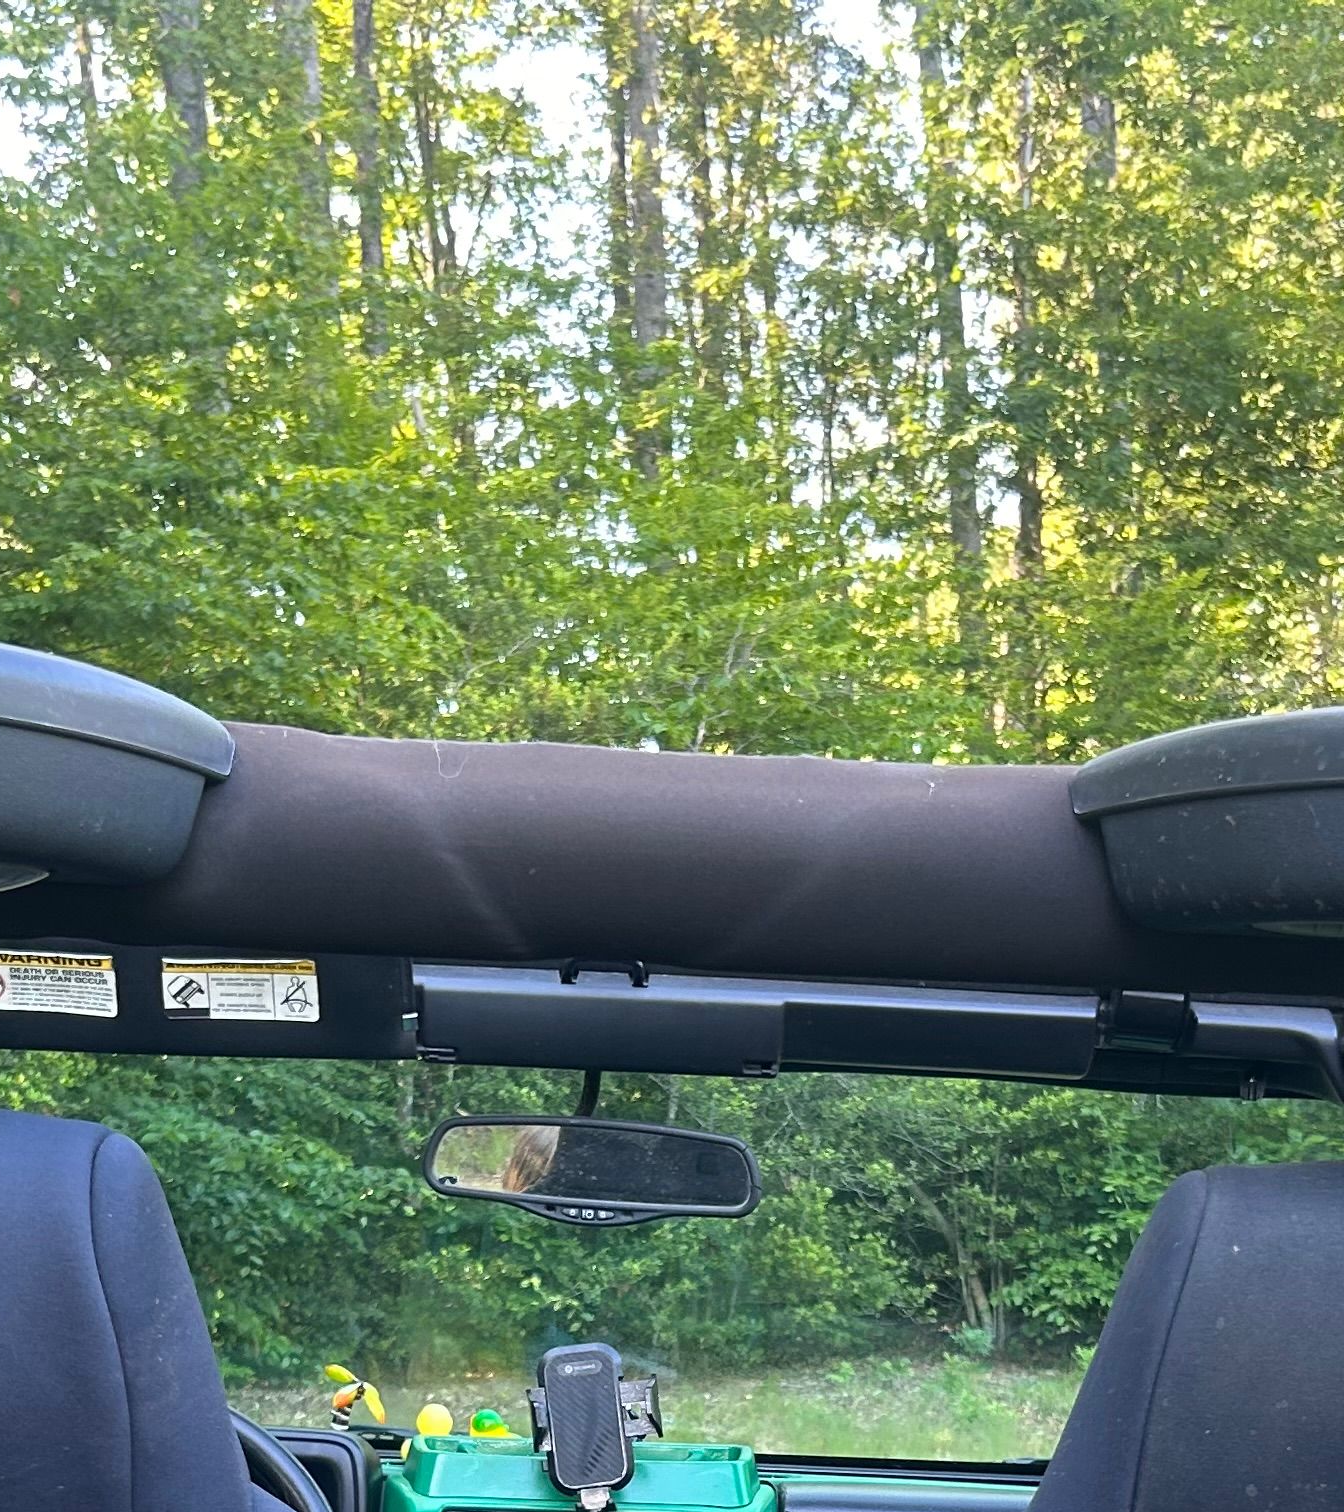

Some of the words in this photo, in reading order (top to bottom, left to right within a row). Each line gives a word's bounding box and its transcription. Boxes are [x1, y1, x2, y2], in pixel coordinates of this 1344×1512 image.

[9, 967, 42, 975] DEATH
[61, 969, 105, 978] SERIOUS
[9, 974, 47, 982] INJURY
[50, 975, 72, 983] CAN
[74, 977, 108, 985] OCCUR
